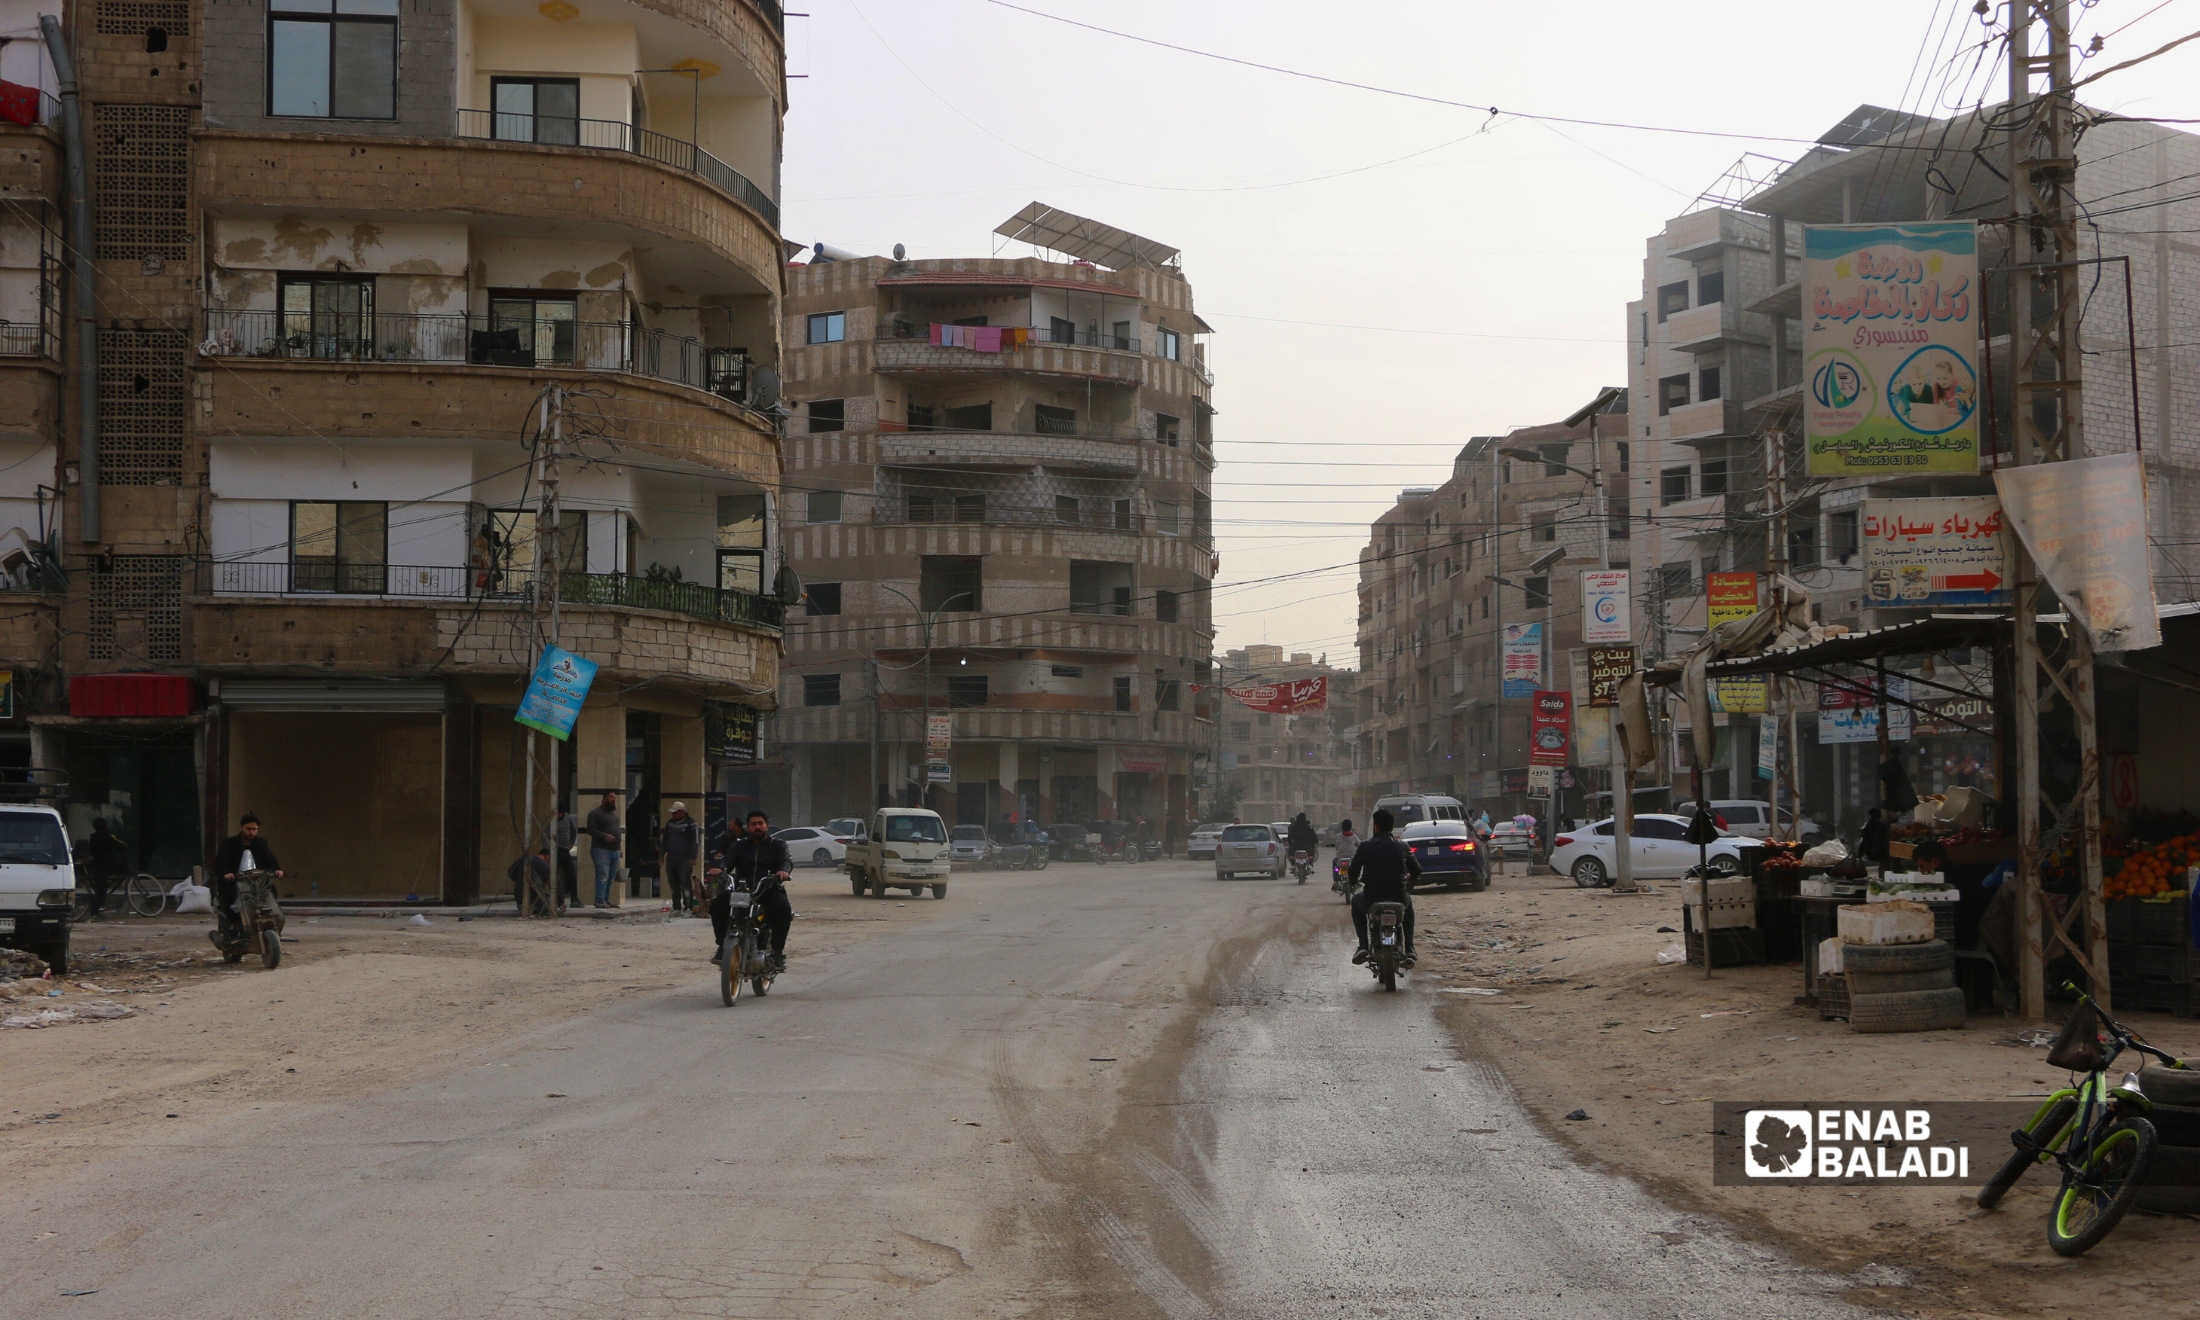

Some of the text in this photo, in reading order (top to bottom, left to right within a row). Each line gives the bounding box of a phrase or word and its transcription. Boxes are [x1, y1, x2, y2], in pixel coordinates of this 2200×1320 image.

[1857, 251, 1923, 283] روضة
[1813, 285, 1912, 323] الخاصة
[1866, 437, 1914, 452] الكورنيش
[1946, 439, 1971, 452] داريا
[1845, 455, 1928, 465] Mob: 0953 63 19 30
[1864, 508, 2003, 542] كهرباء سيارات
[1874, 548, 1914, 557] السيارات
[1937, 546, 1963, 555] جميع
[1966, 543, 1995, 554] صيانة
[1712, 575, 1751, 589] عيادة
[1710, 590, 1754, 604] الحكيم
[1711, 608, 1731, 617] داخلية
[1735, 607, 1754, 616] جراحة
[1607, 650, 1630, 662] بيت
[1592, 665, 1632, 681] التوفير
[1540, 699, 1565, 709] Saida
[725, 724, 752, 743] جوهرة
[1531, 769, 1549, 777] داوود
